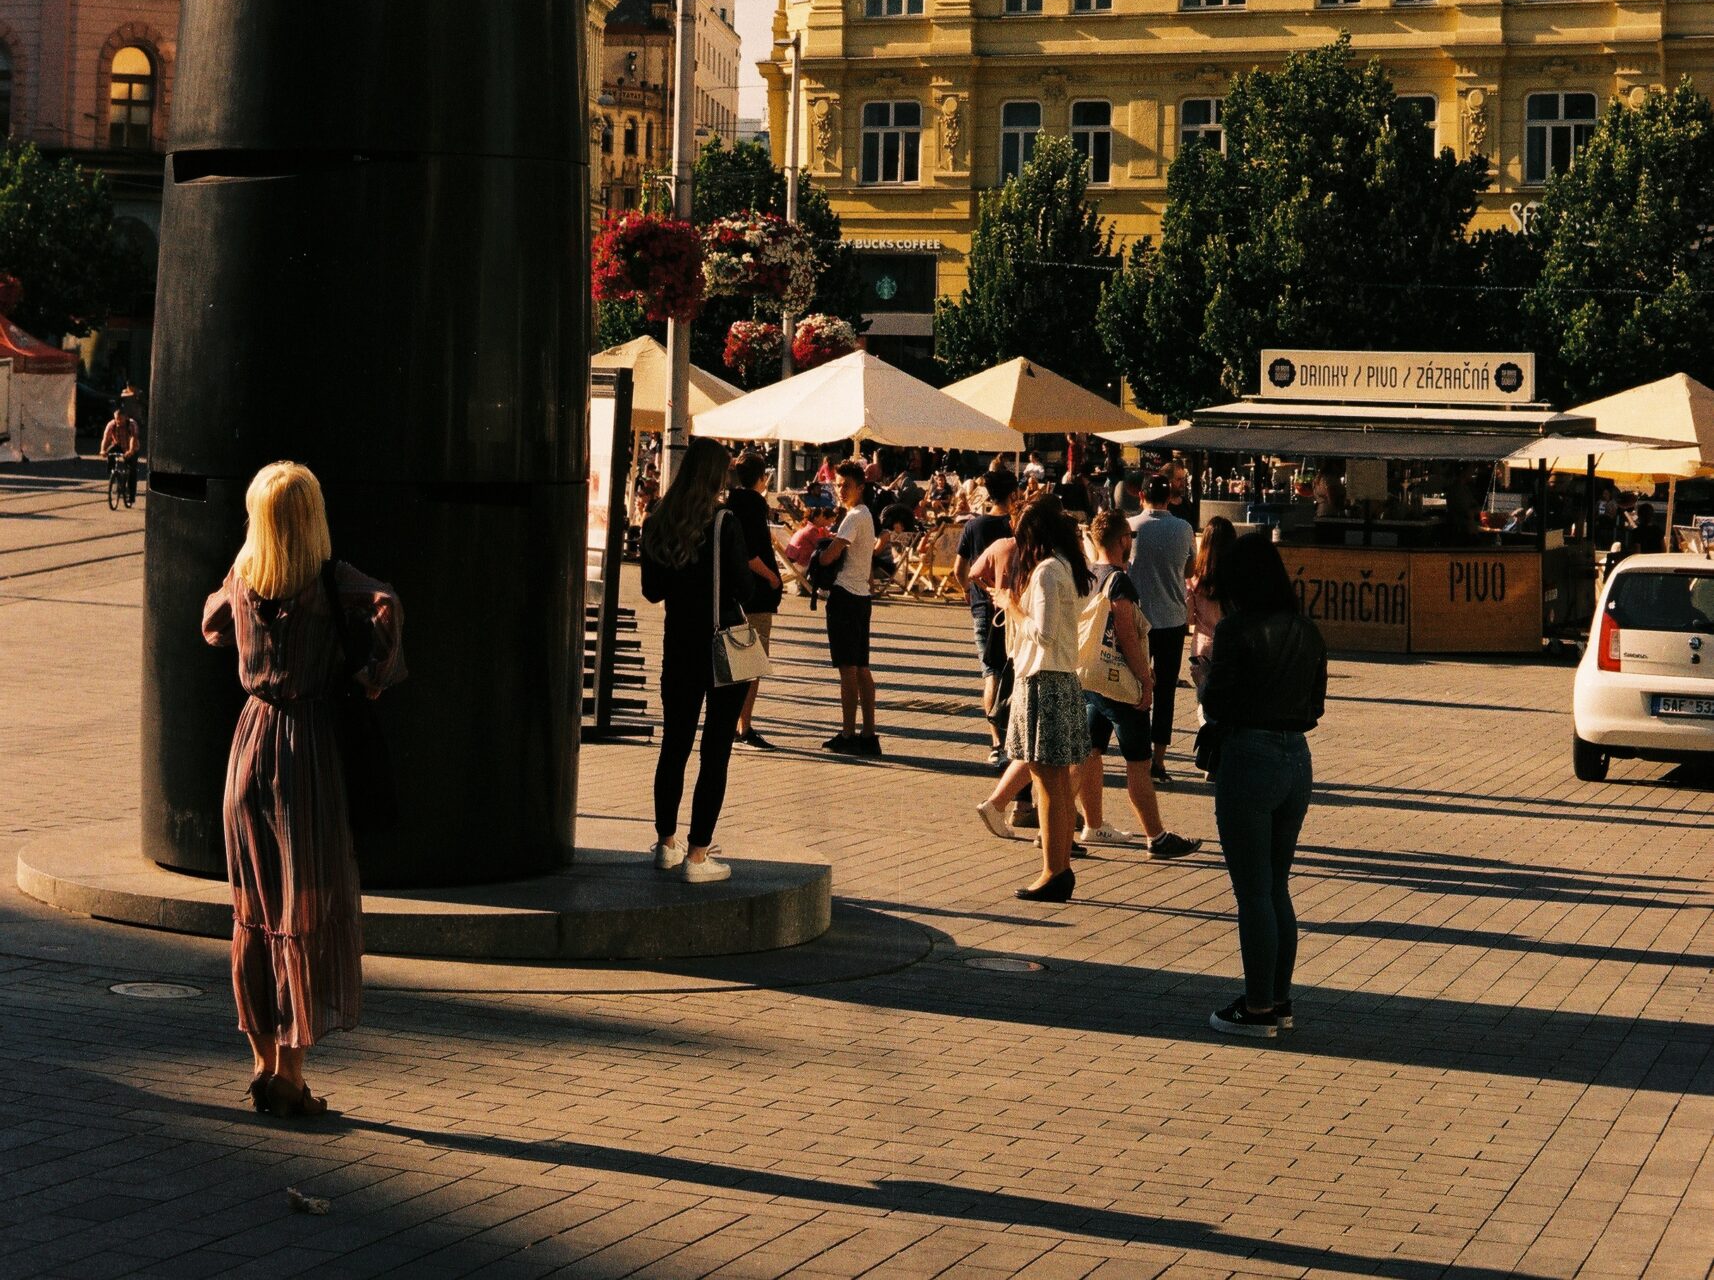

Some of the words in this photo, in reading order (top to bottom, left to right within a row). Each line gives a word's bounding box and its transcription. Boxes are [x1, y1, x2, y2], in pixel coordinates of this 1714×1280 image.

[896, 240, 941, 250] COFFEE
[1300, 364, 1349, 387] DRINKY
[1367, 365, 1398, 389] PIVO
[1416, 360, 1490, 391] ZÁZRAČNÁ
[1292, 566, 1406, 625] ÁZRAČNÁ
[1450, 561, 1505, 603] PIVO
